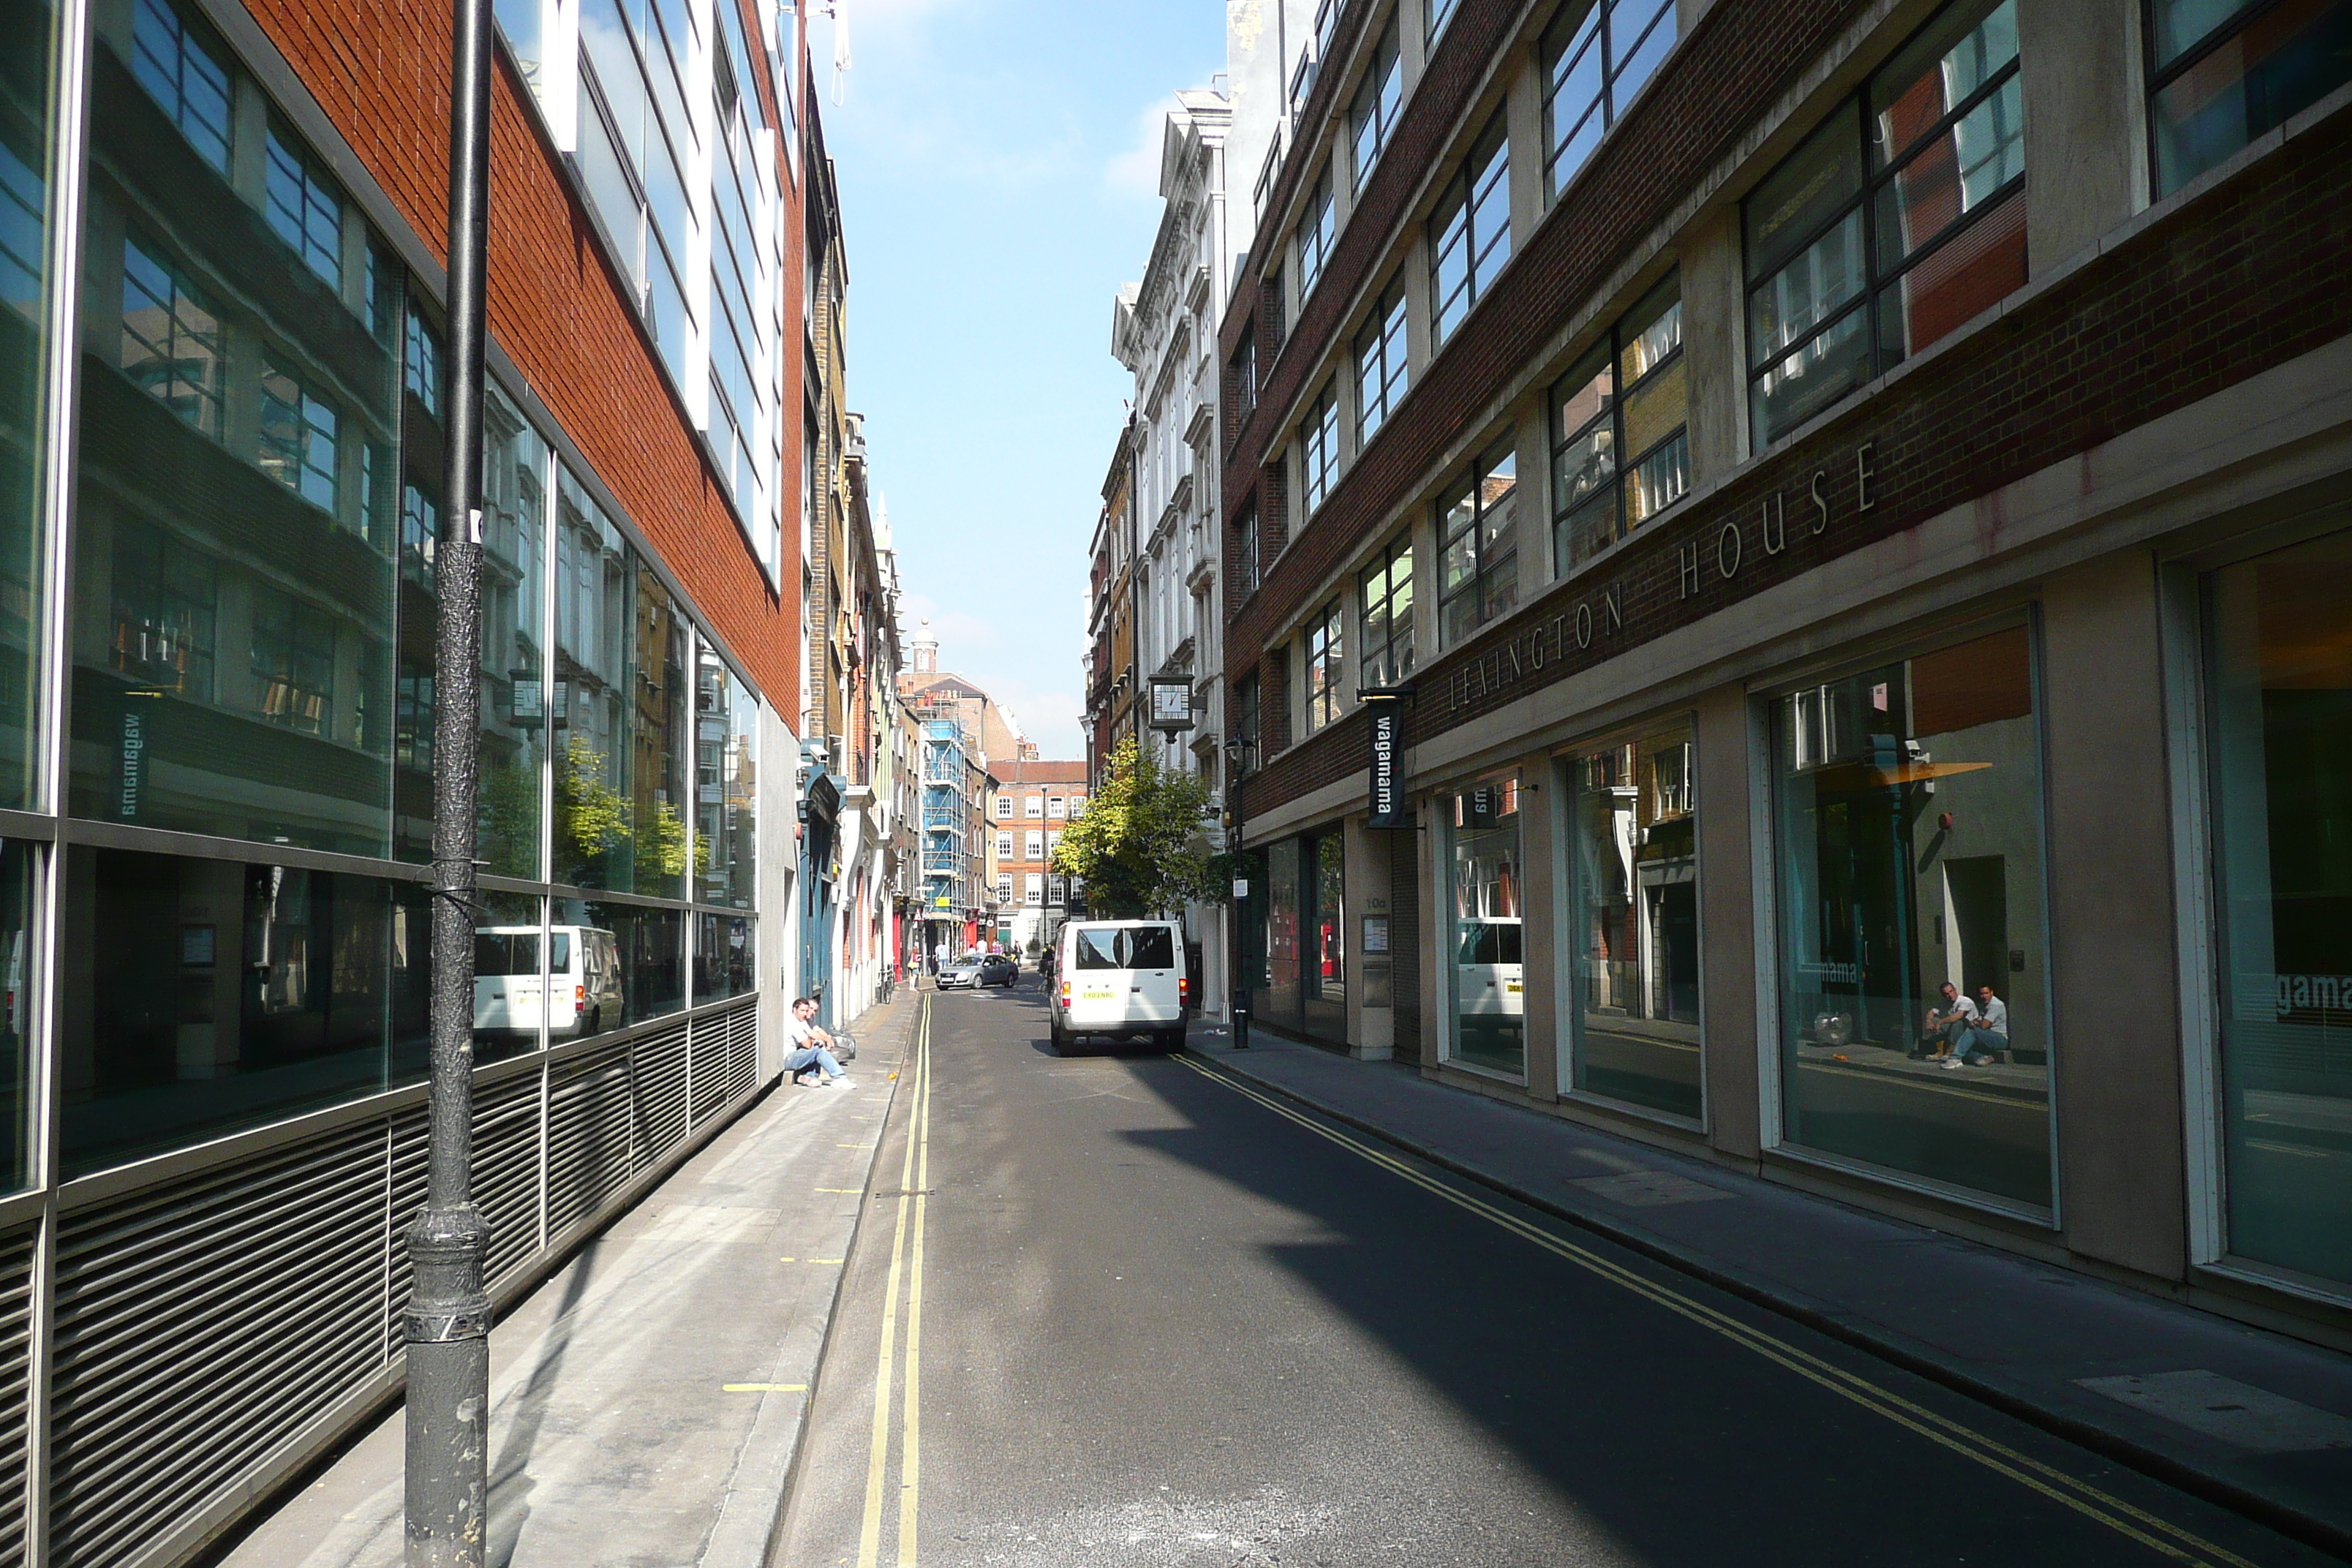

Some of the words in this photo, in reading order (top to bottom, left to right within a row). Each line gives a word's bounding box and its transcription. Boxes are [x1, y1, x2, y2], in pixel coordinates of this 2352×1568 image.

[1451, 584, 1622, 712] LEXINGTON
[1680, 442, 1874, 600] HOUSE
[1374, 715, 1391, 814] wagamama
